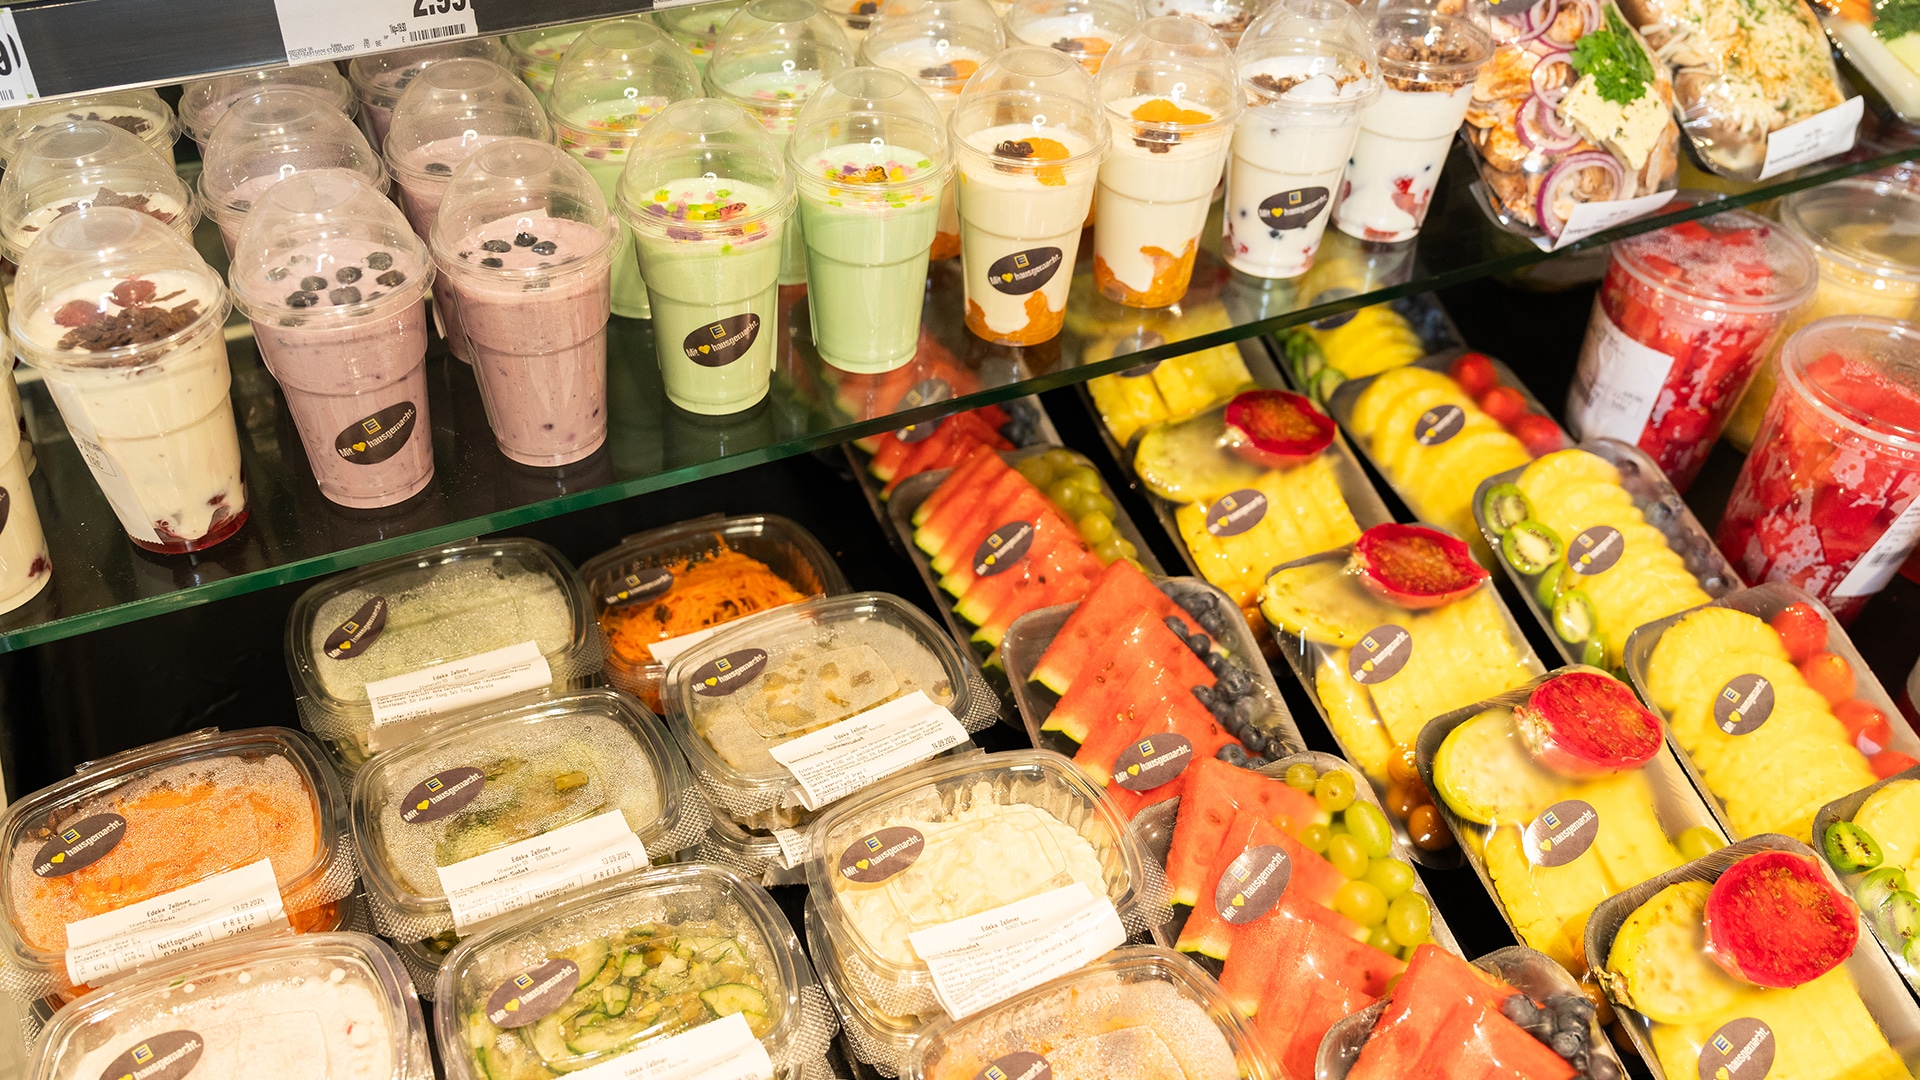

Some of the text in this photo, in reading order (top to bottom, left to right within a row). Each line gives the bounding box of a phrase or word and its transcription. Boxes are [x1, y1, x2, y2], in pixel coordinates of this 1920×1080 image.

[686, 320, 758, 358] Mit hausgemacht.
[338, 409, 414, 458] Mit hausgemacht.
[328, 600, 384, 658] Mit hausgemacht.
[692, 654, 766, 692] Mit hausgemacht.
[1114, 744, 1190, 784] Mit hausgemacht.
[404, 772, 482, 822] Mit hausgemacht.
[36, 820, 124, 876] Mit hausgemacht.
[1550, 810, 1596, 846] hausgemacht.
[842, 836, 922, 878] Mit hausgemacht.
[145, 898, 191, 917] Edeka Zellmer
[1222, 852, 1286, 921] Mit hausgemacht.
[156, 929, 204, 951] Nettogewicht
[490, 966, 576, 1024] Mit hausgemacht.
[1724, 1026, 1770, 1074] hausgemacht.
